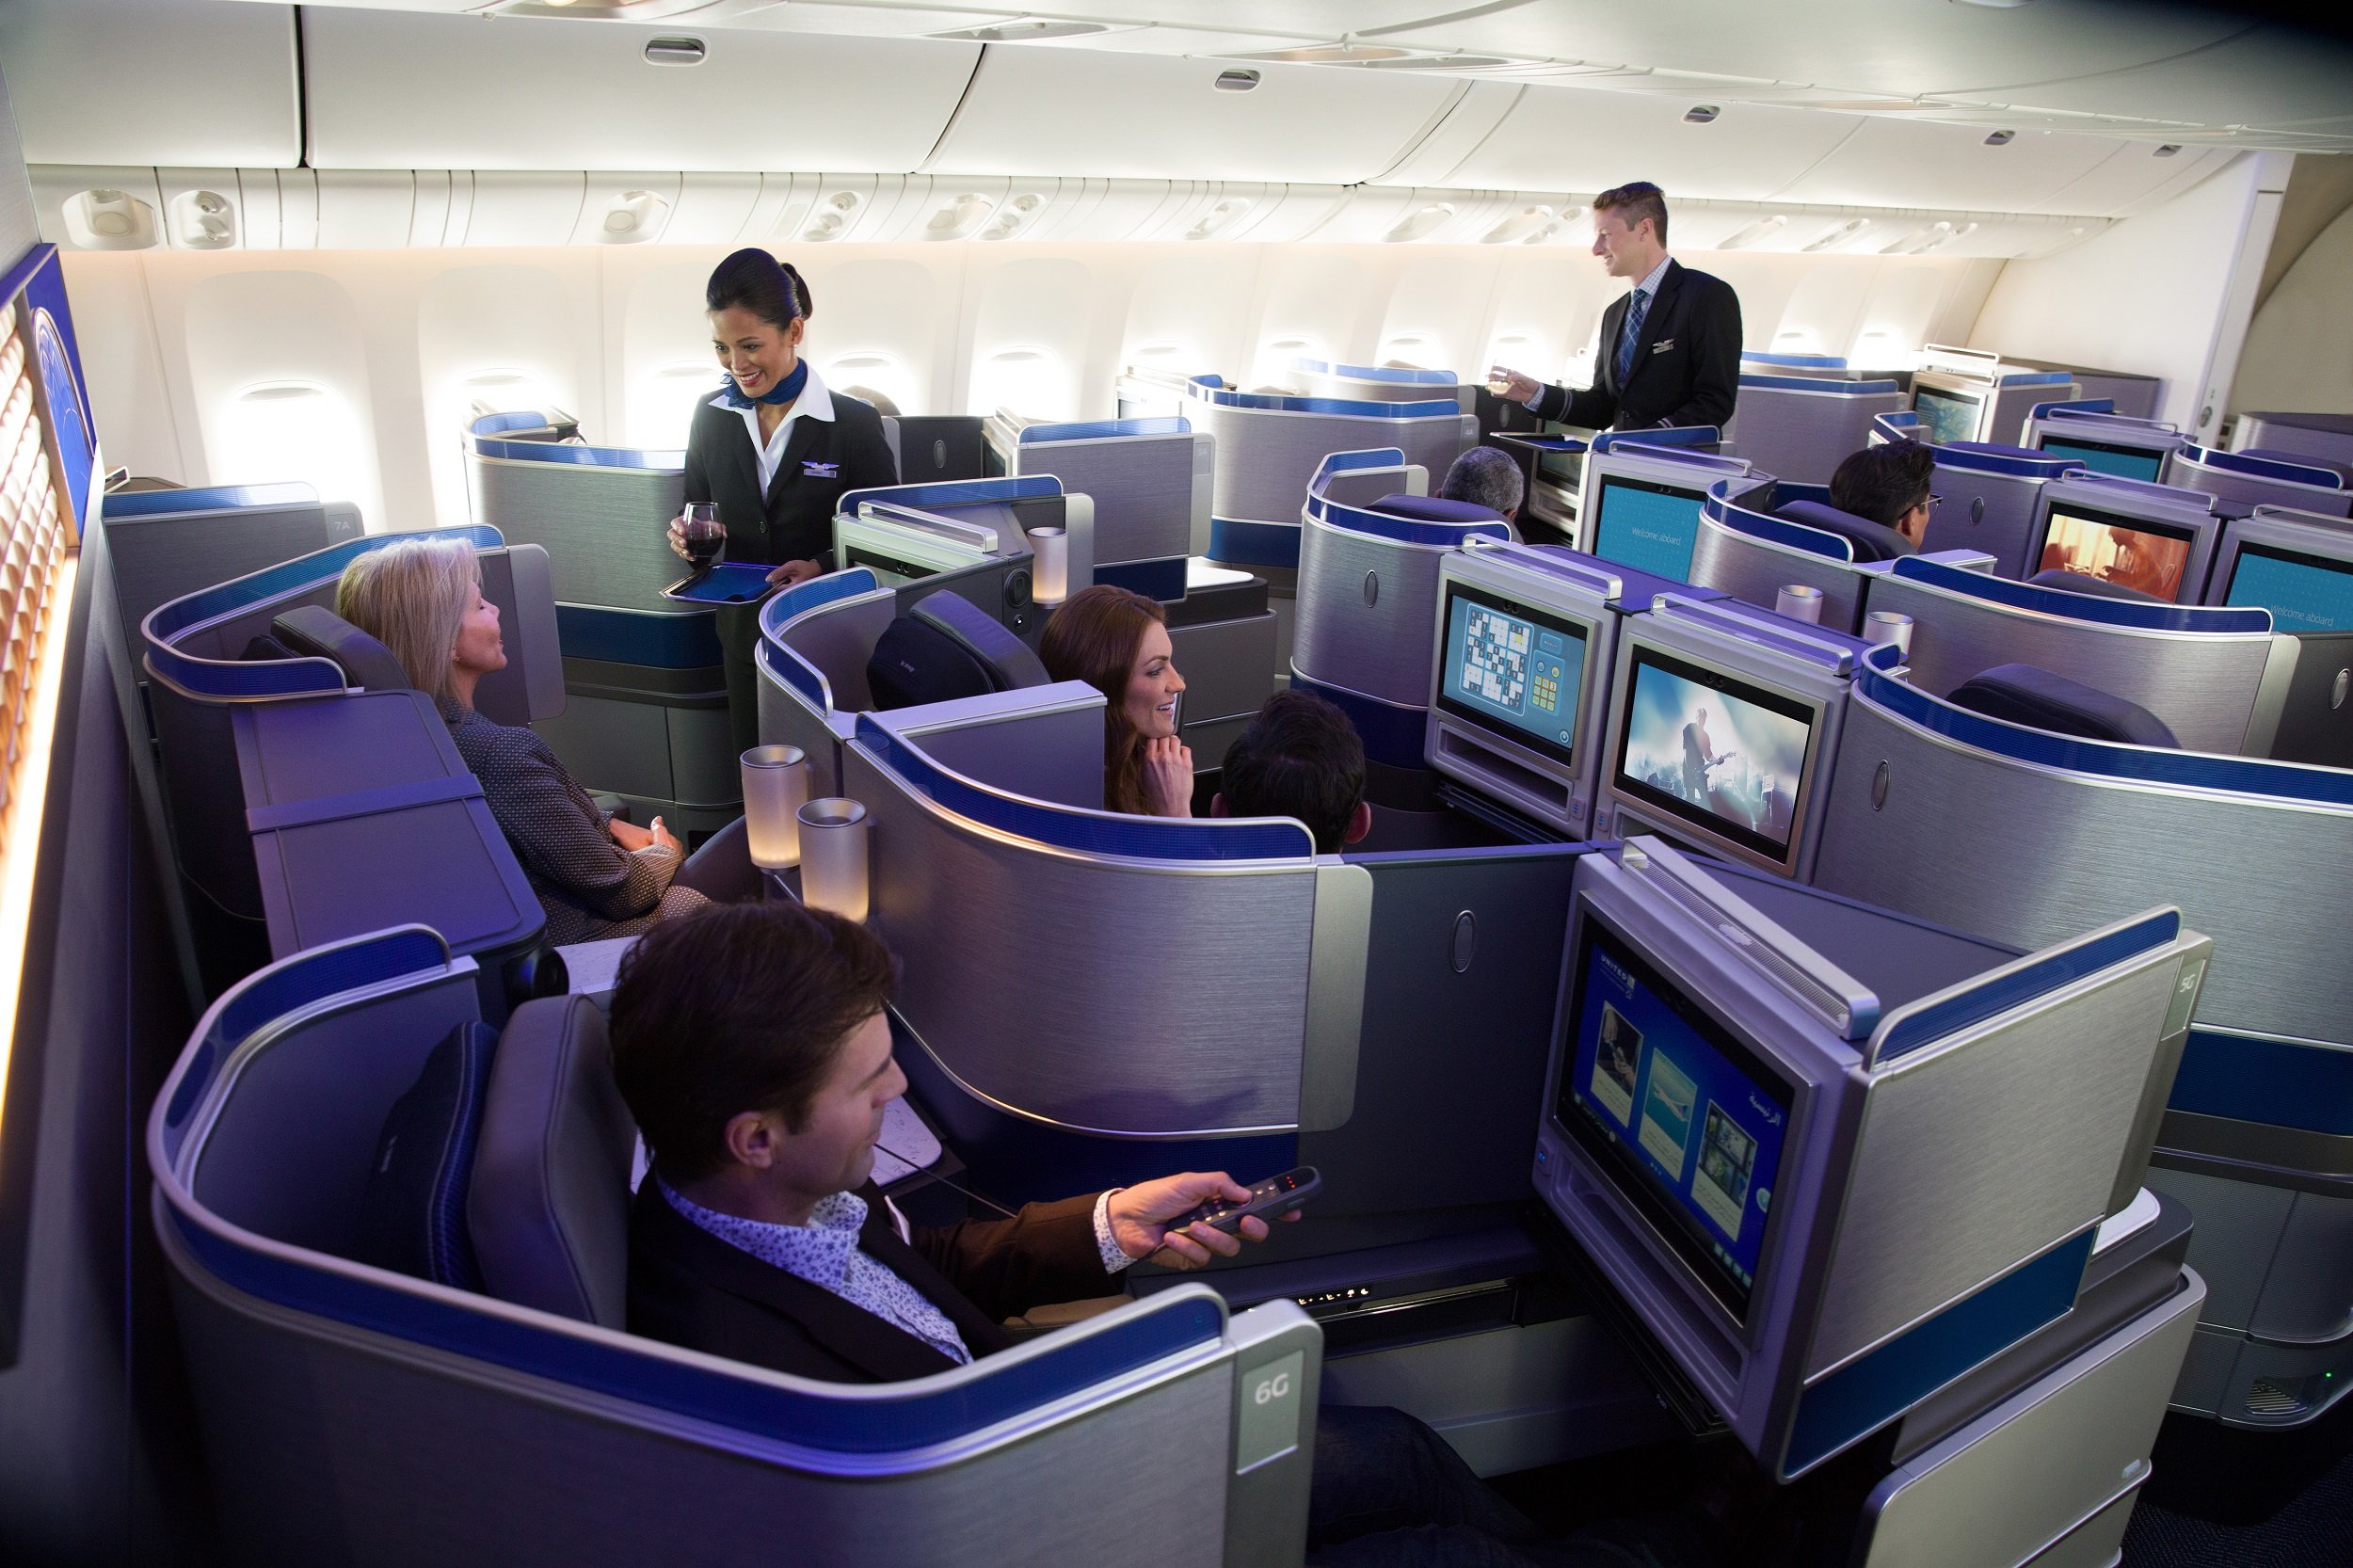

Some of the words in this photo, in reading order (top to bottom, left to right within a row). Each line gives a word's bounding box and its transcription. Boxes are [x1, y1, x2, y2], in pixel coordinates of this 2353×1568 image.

[334, 520, 350, 531] 7A
[1632, 527, 1657, 540] Welcome
[1659, 534, 1681, 545] aboard
[2270, 604, 2304, 620] Welcome
[2306, 612, 2334, 626] aboard
[1601, 954, 1627, 980] UNITED
[2179, 973, 2196, 993] 5G
[1255, 1373, 1289, 1404] 6G
